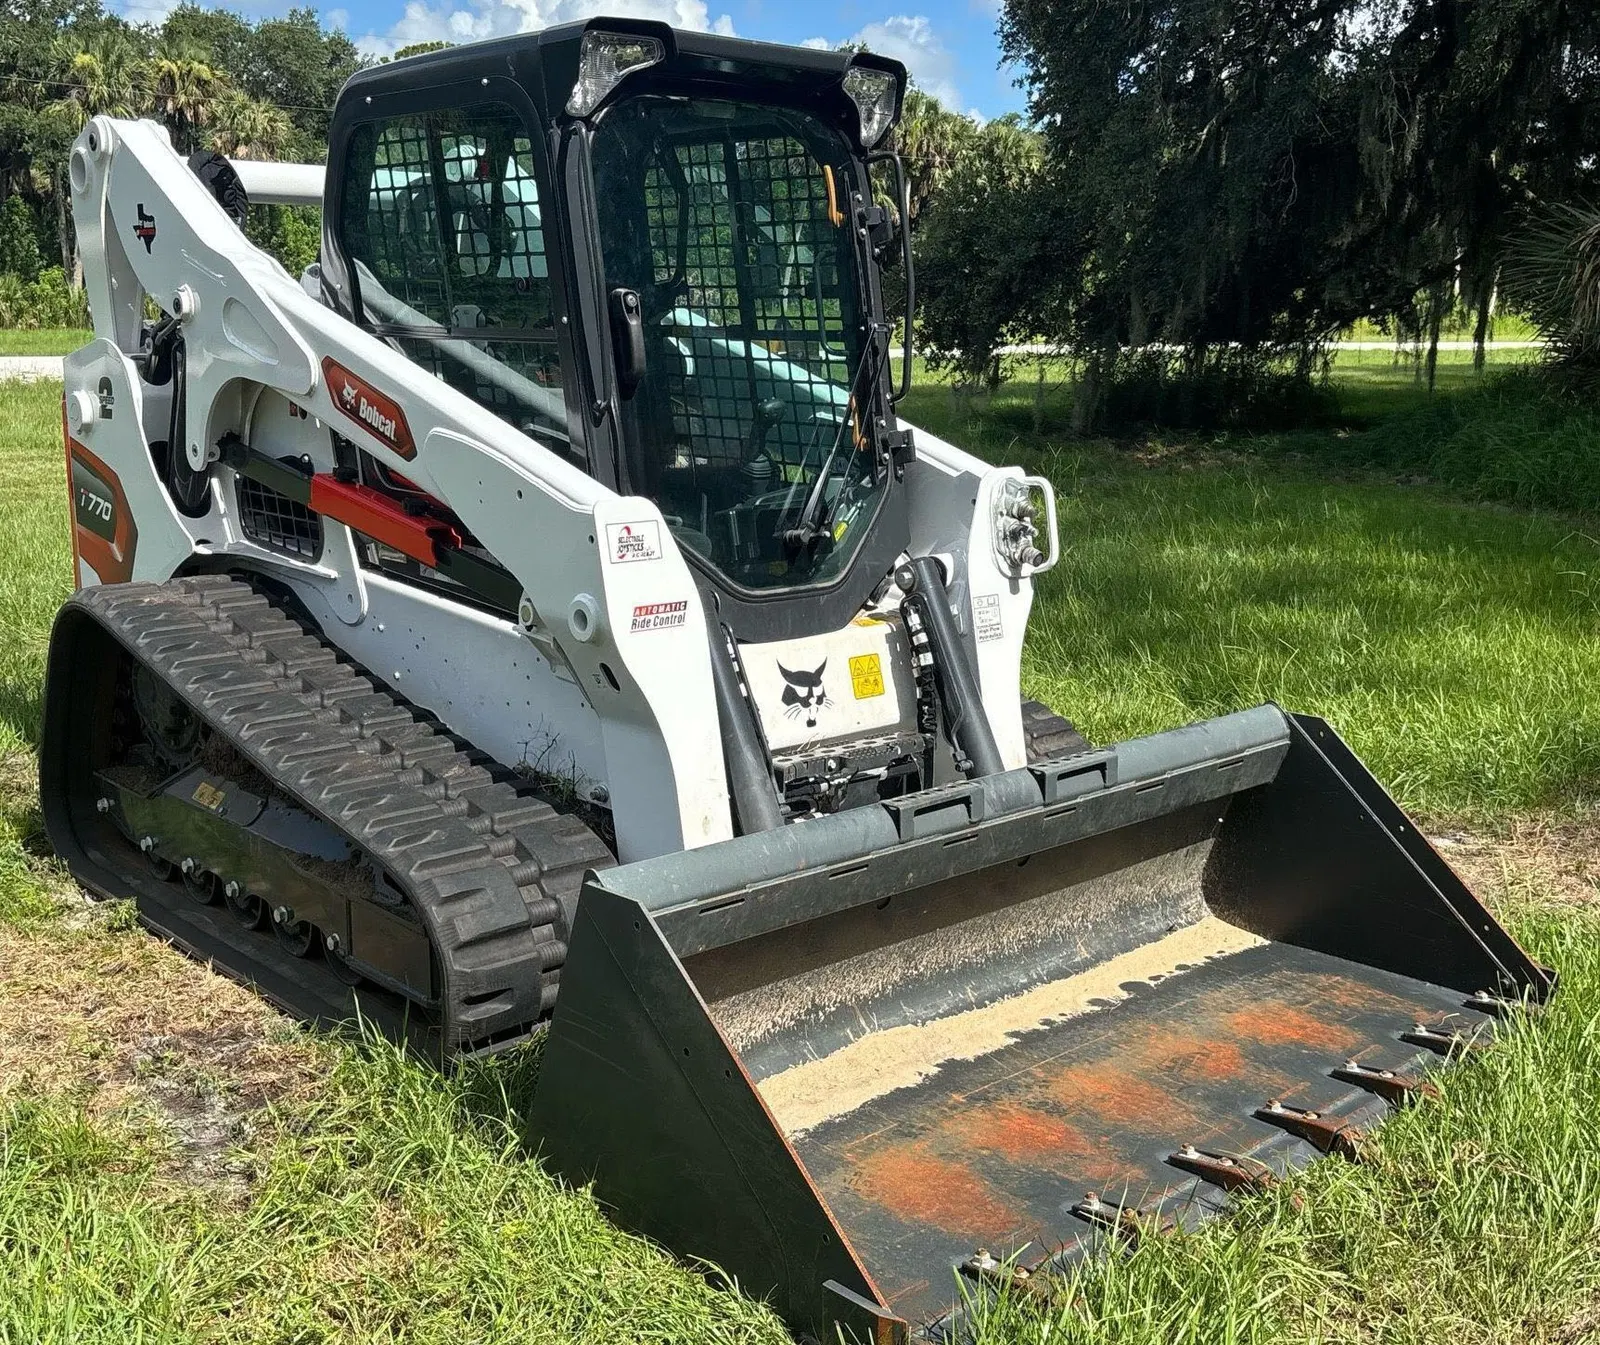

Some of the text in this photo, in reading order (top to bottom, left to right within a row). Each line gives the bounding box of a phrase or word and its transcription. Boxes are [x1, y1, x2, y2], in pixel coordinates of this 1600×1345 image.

[98, 395, 115, 405] SPEED
[359, 396, 397, 441] Bobcat
[80, 487, 112, 521] T770
[616, 543, 645, 553] JOYSTICKS
[633, 602, 686, 617] AUTOMATIC
[631, 612, 686, 630] Ride Control
